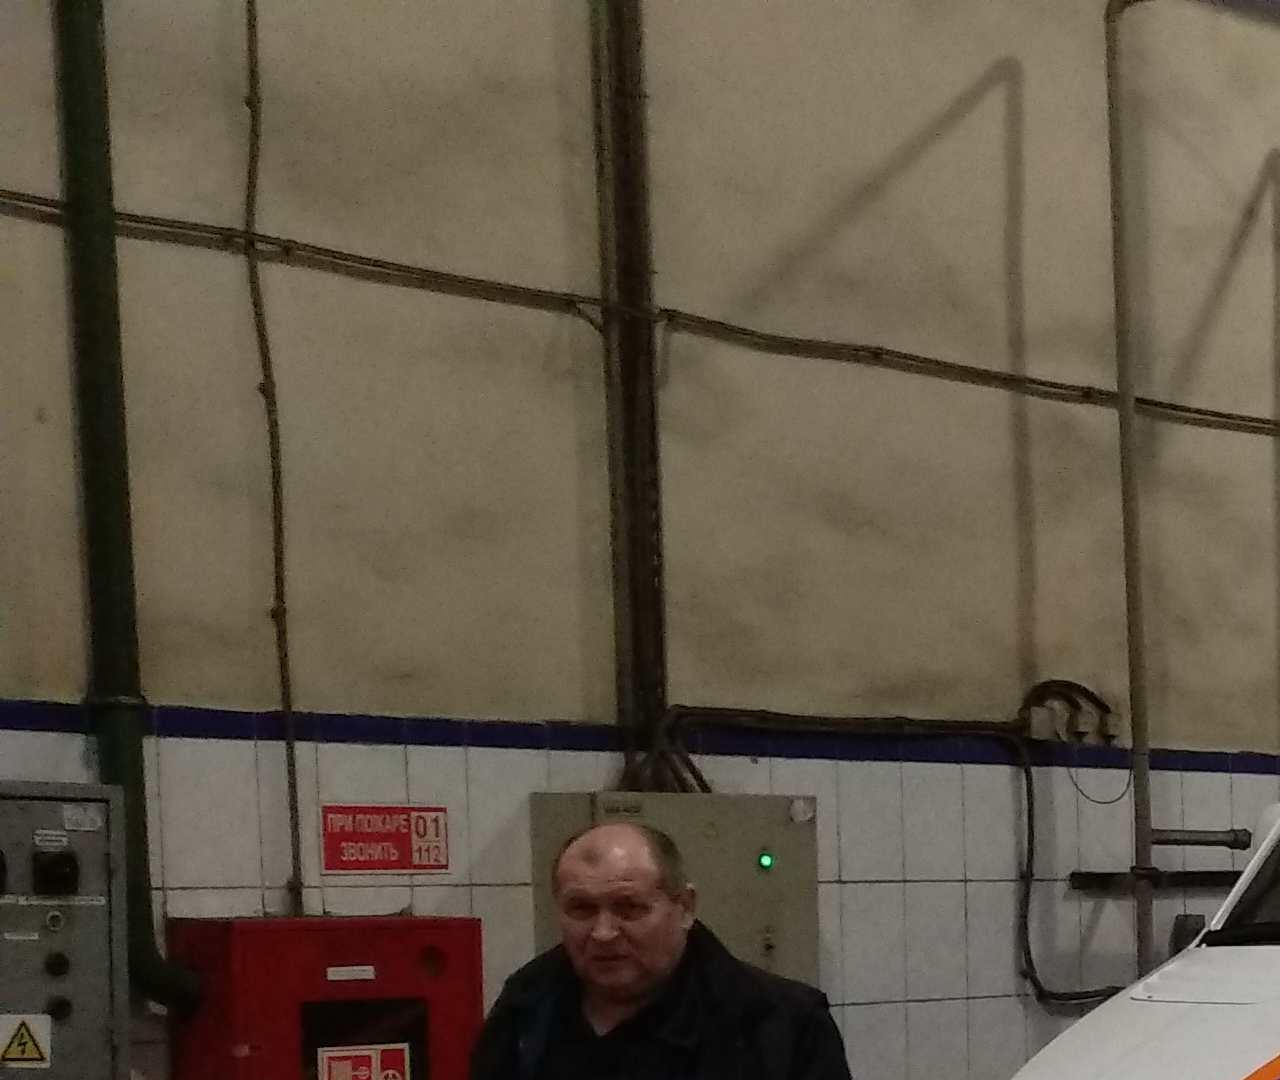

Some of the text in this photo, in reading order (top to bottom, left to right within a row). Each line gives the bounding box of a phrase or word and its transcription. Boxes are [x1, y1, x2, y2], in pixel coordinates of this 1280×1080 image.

[327, 813, 410, 833] ПРИ ПОЖАРЕ
[415, 815, 440, 838] 01
[340, 842, 399, 861] ЗВОНИТЬ
[414, 845, 441, 862] 112
